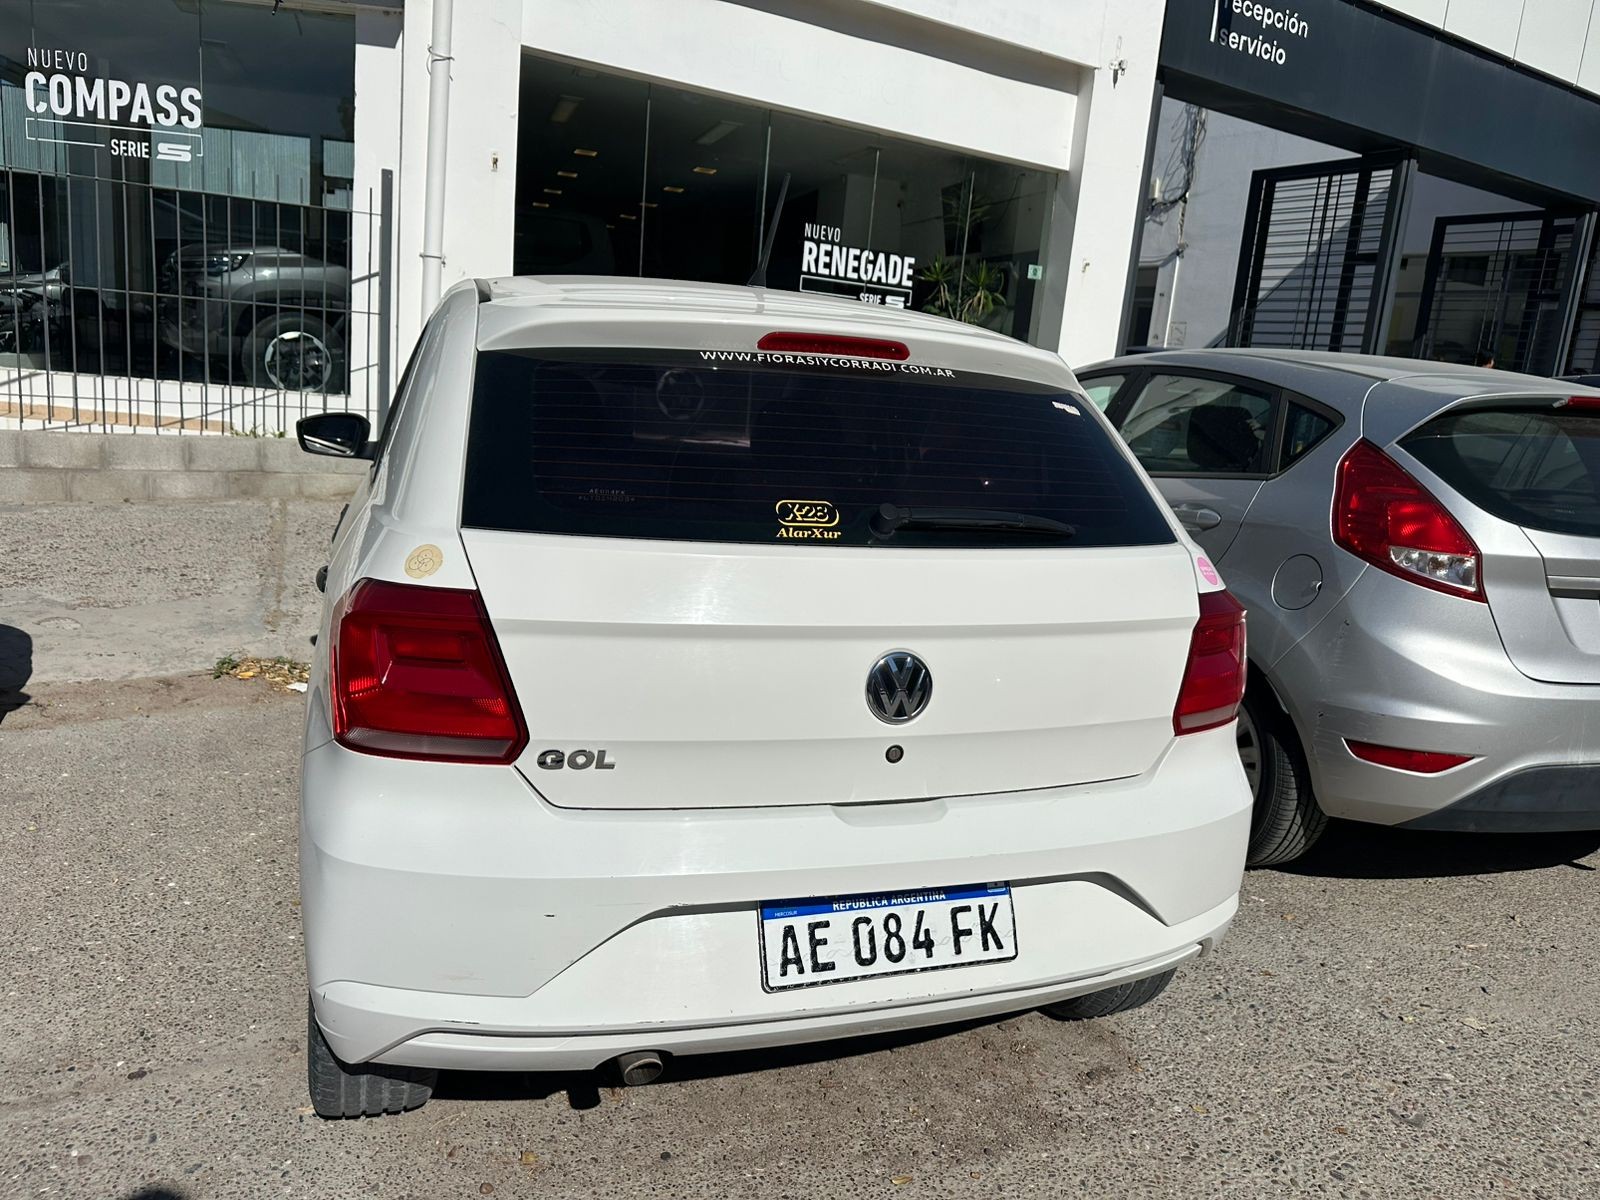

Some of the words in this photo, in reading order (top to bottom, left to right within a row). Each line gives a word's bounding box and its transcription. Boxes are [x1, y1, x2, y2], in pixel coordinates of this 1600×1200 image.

[1219, 28, 1286, 65] servicio
[27, 48, 88, 72] NUEVO
[25, 71, 202, 129] COMPASS
[110, 138, 150, 158] SERIE
[804, 222, 841, 243] NUEVO
[802, 240, 915, 287] RENEGADE
[700, 350, 956, 378] WWW.FIORASIYCORRADI.COM.AR
[537, 749, 616, 770] GOL
[891, 889, 946, 905] ARGENTINA
[780, 920, 836, 977] AE
[852, 909, 935, 967] 084
[950, 902, 1004, 956] FK
